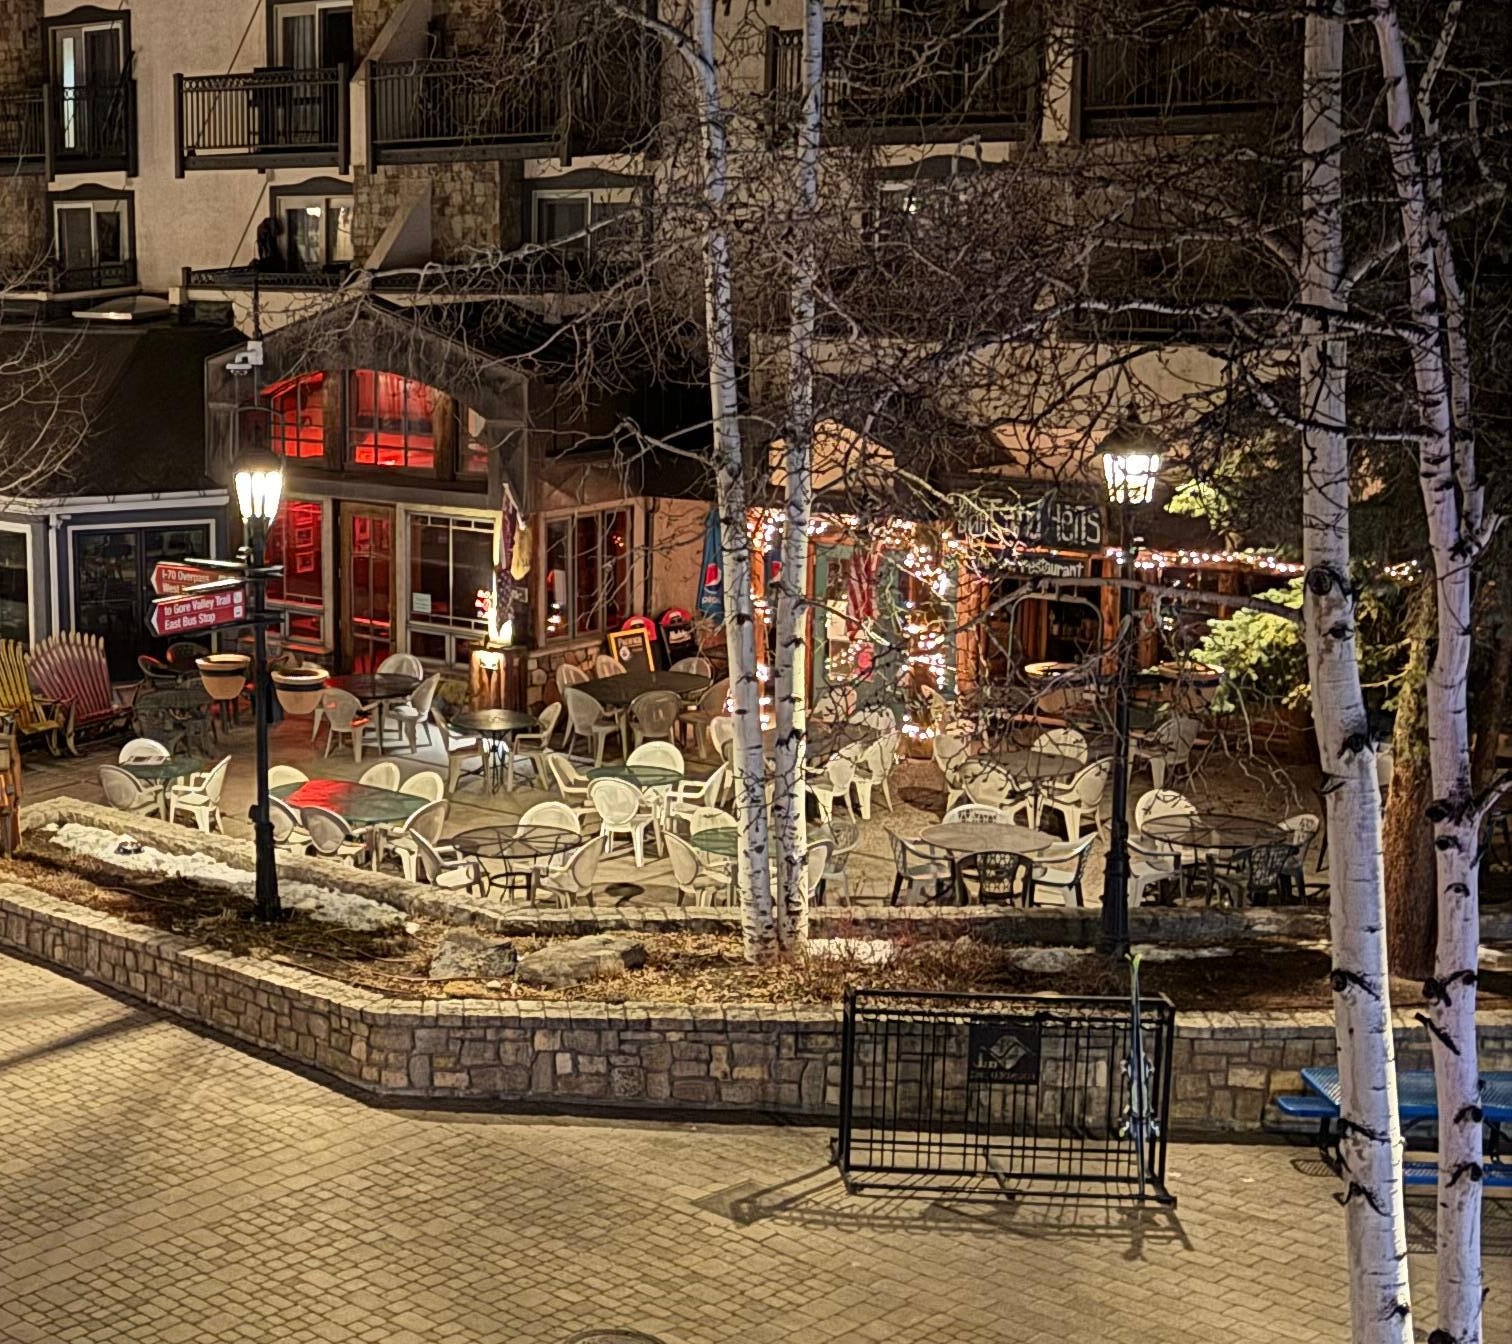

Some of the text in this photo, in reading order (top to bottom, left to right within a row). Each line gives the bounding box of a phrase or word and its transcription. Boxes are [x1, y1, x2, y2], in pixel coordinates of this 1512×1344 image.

[161, 569, 177, 580] I-70
[164, 594, 231, 616] to Gore Valley Trail
[164, 613, 216, 630] East Bus Stop
